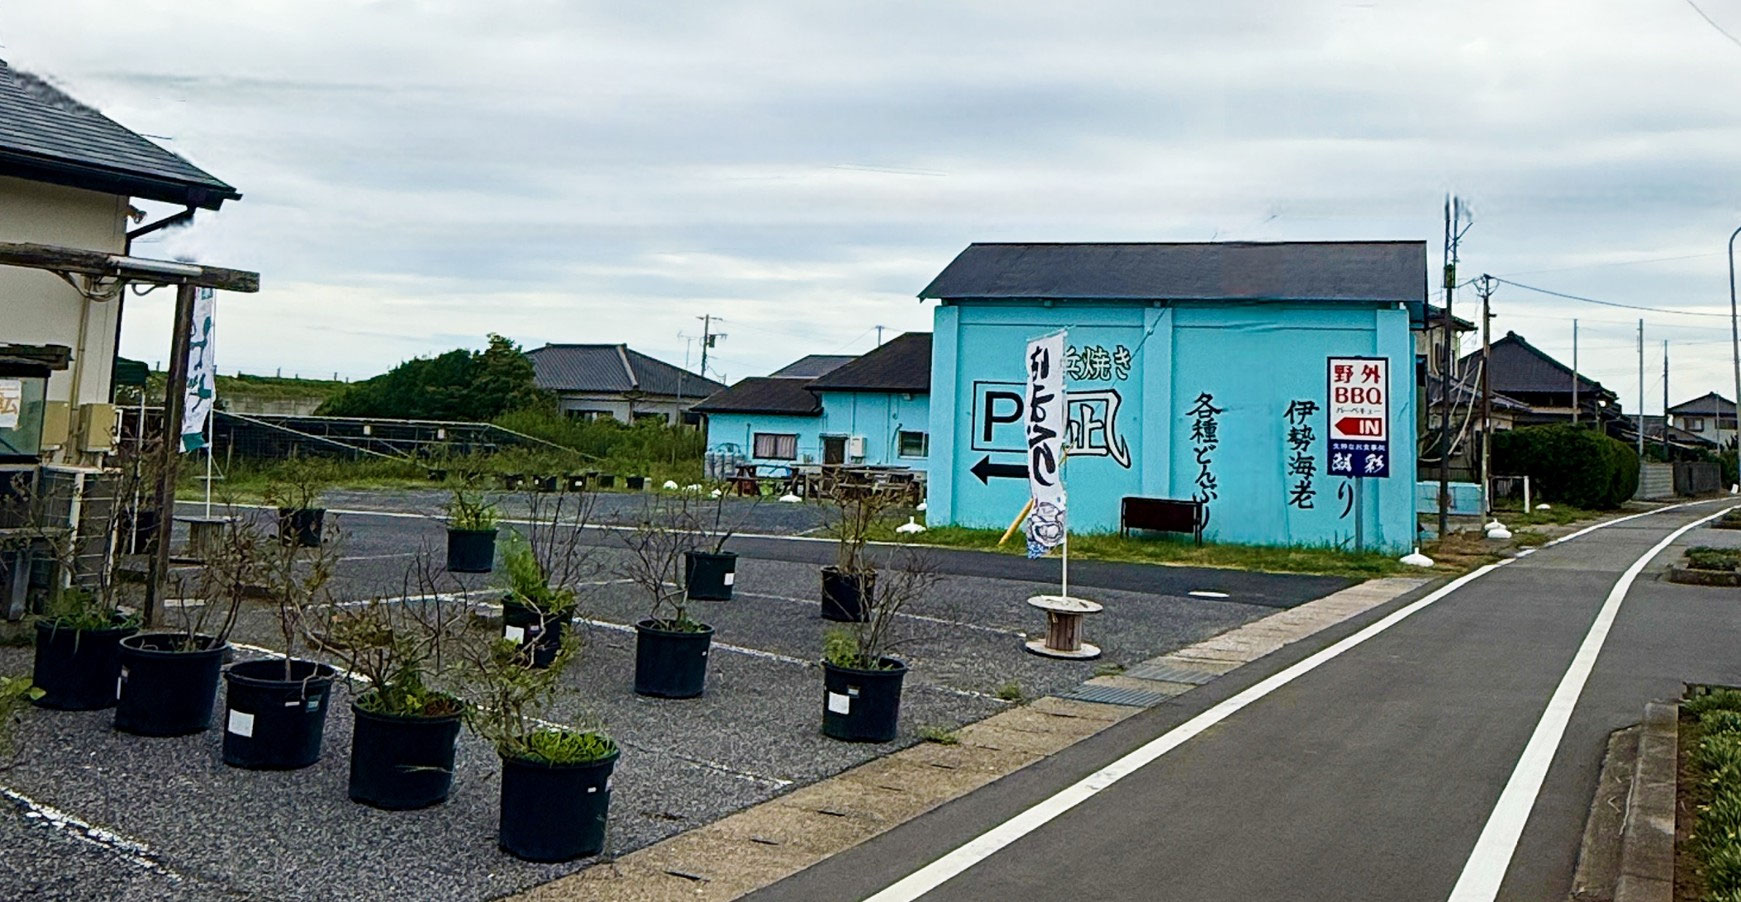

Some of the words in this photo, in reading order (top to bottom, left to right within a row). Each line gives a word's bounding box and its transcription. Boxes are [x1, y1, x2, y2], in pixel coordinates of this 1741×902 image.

[1334, 364, 1381, 384] 野外
[1335, 387, 1382, 405] BBQ
[983, 391, 1024, 442] P
[1359, 420, 1380, 434] IN
[1185, 392, 1222, 531] 各種どんぶり
[1284, 400, 1320, 509] 伊勢海老
